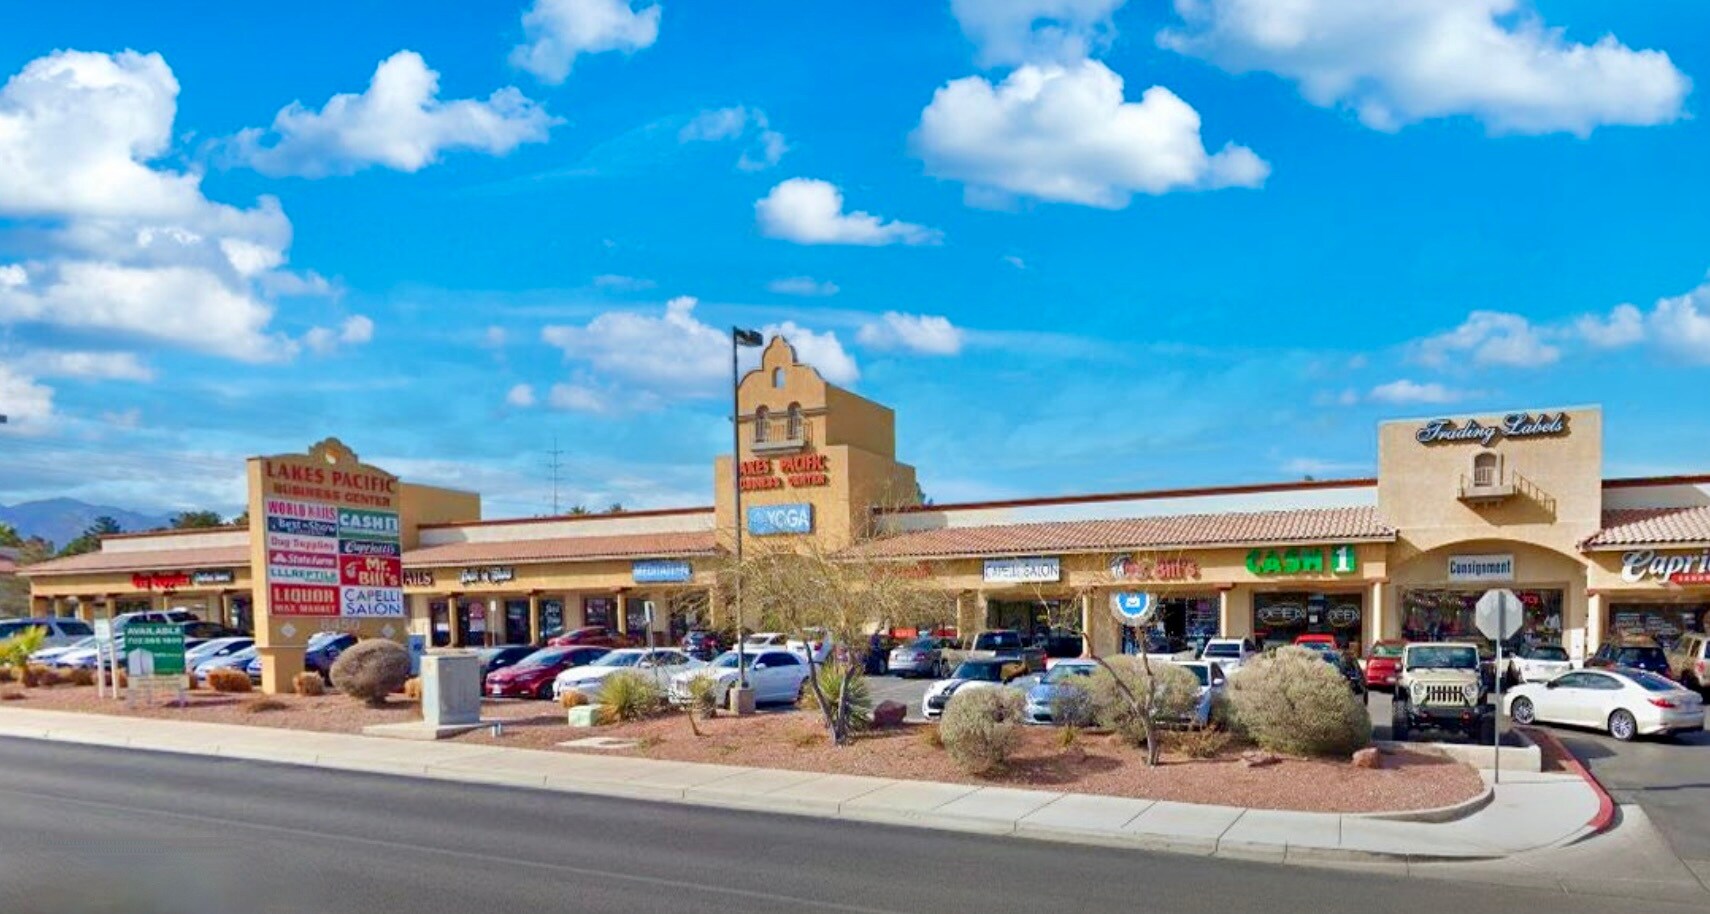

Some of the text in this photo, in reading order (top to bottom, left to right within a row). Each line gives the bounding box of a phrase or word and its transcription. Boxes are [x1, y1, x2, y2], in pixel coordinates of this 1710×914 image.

[1416, 412, 1564, 445] Trading Labels
[740, 454, 827, 475] AKES PACIFIC
[266, 461, 398, 492] LAKES PACIFIC
[268, 500, 306, 517] WORLD
[340, 514, 383, 529] CASH
[767, 508, 810, 529] YOGA
[365, 557, 392, 572] Mr.
[1246, 547, 1324, 574] CASH
[1450, 559, 1511, 575] Consignment
[1621, 549, 1710, 584] Capri
[358, 571, 398, 586] Bill's
[402, 569, 432, 585] AILS
[1024, 564, 1057, 579] SALON
[274, 588, 335, 603] LIQUOR
[344, 588, 399, 602] CAPELLI
[346, 602, 400, 615] SALON
[127, 626, 181, 635] AVAILABLE
